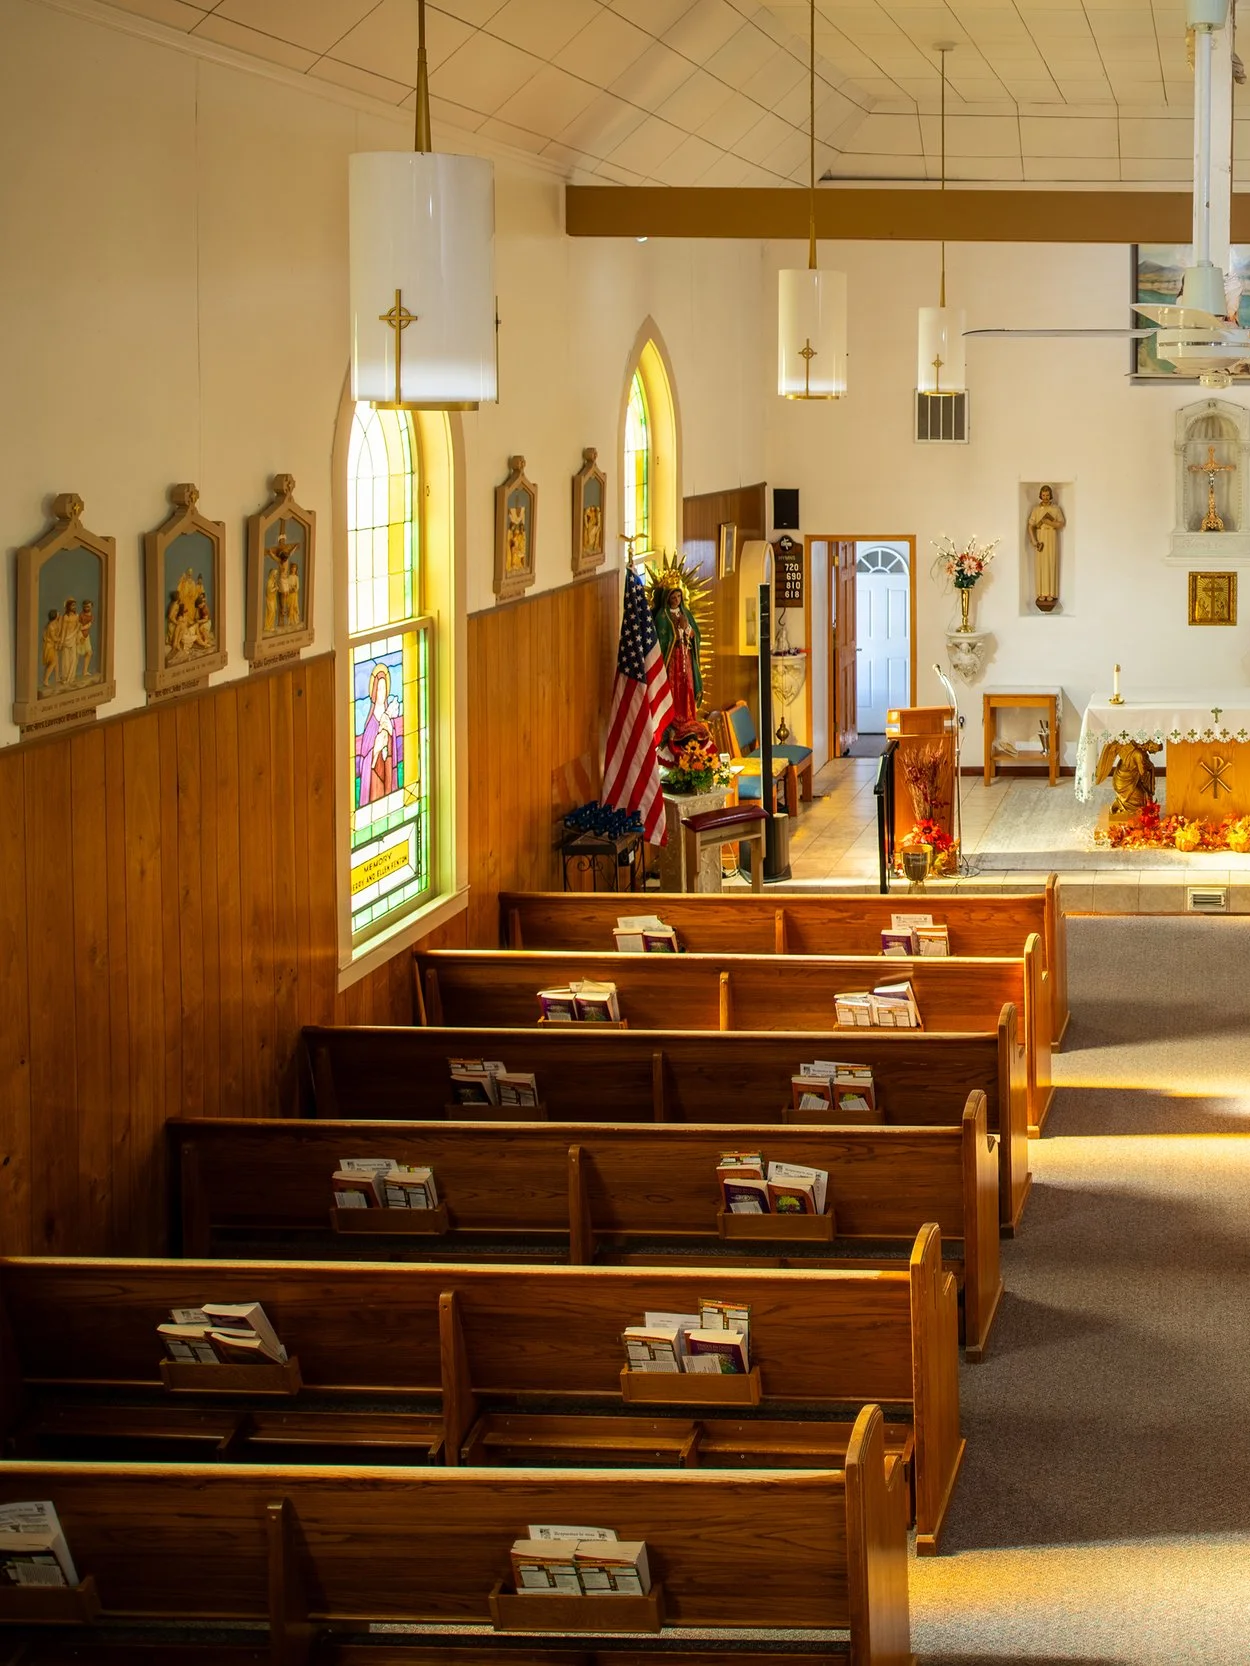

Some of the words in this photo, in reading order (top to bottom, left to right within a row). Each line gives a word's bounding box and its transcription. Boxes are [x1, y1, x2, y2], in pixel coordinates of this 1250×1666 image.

[784, 563, 799, 571] 720
[786, 572, 802, 580] 690
[786, 581, 801, 590] 810
[784, 590, 800, 599] 618
[363, 852, 393, 872] MEMORY
[366, 873, 376, 883] AND
[377, 866, 390, 878] ELLEN
